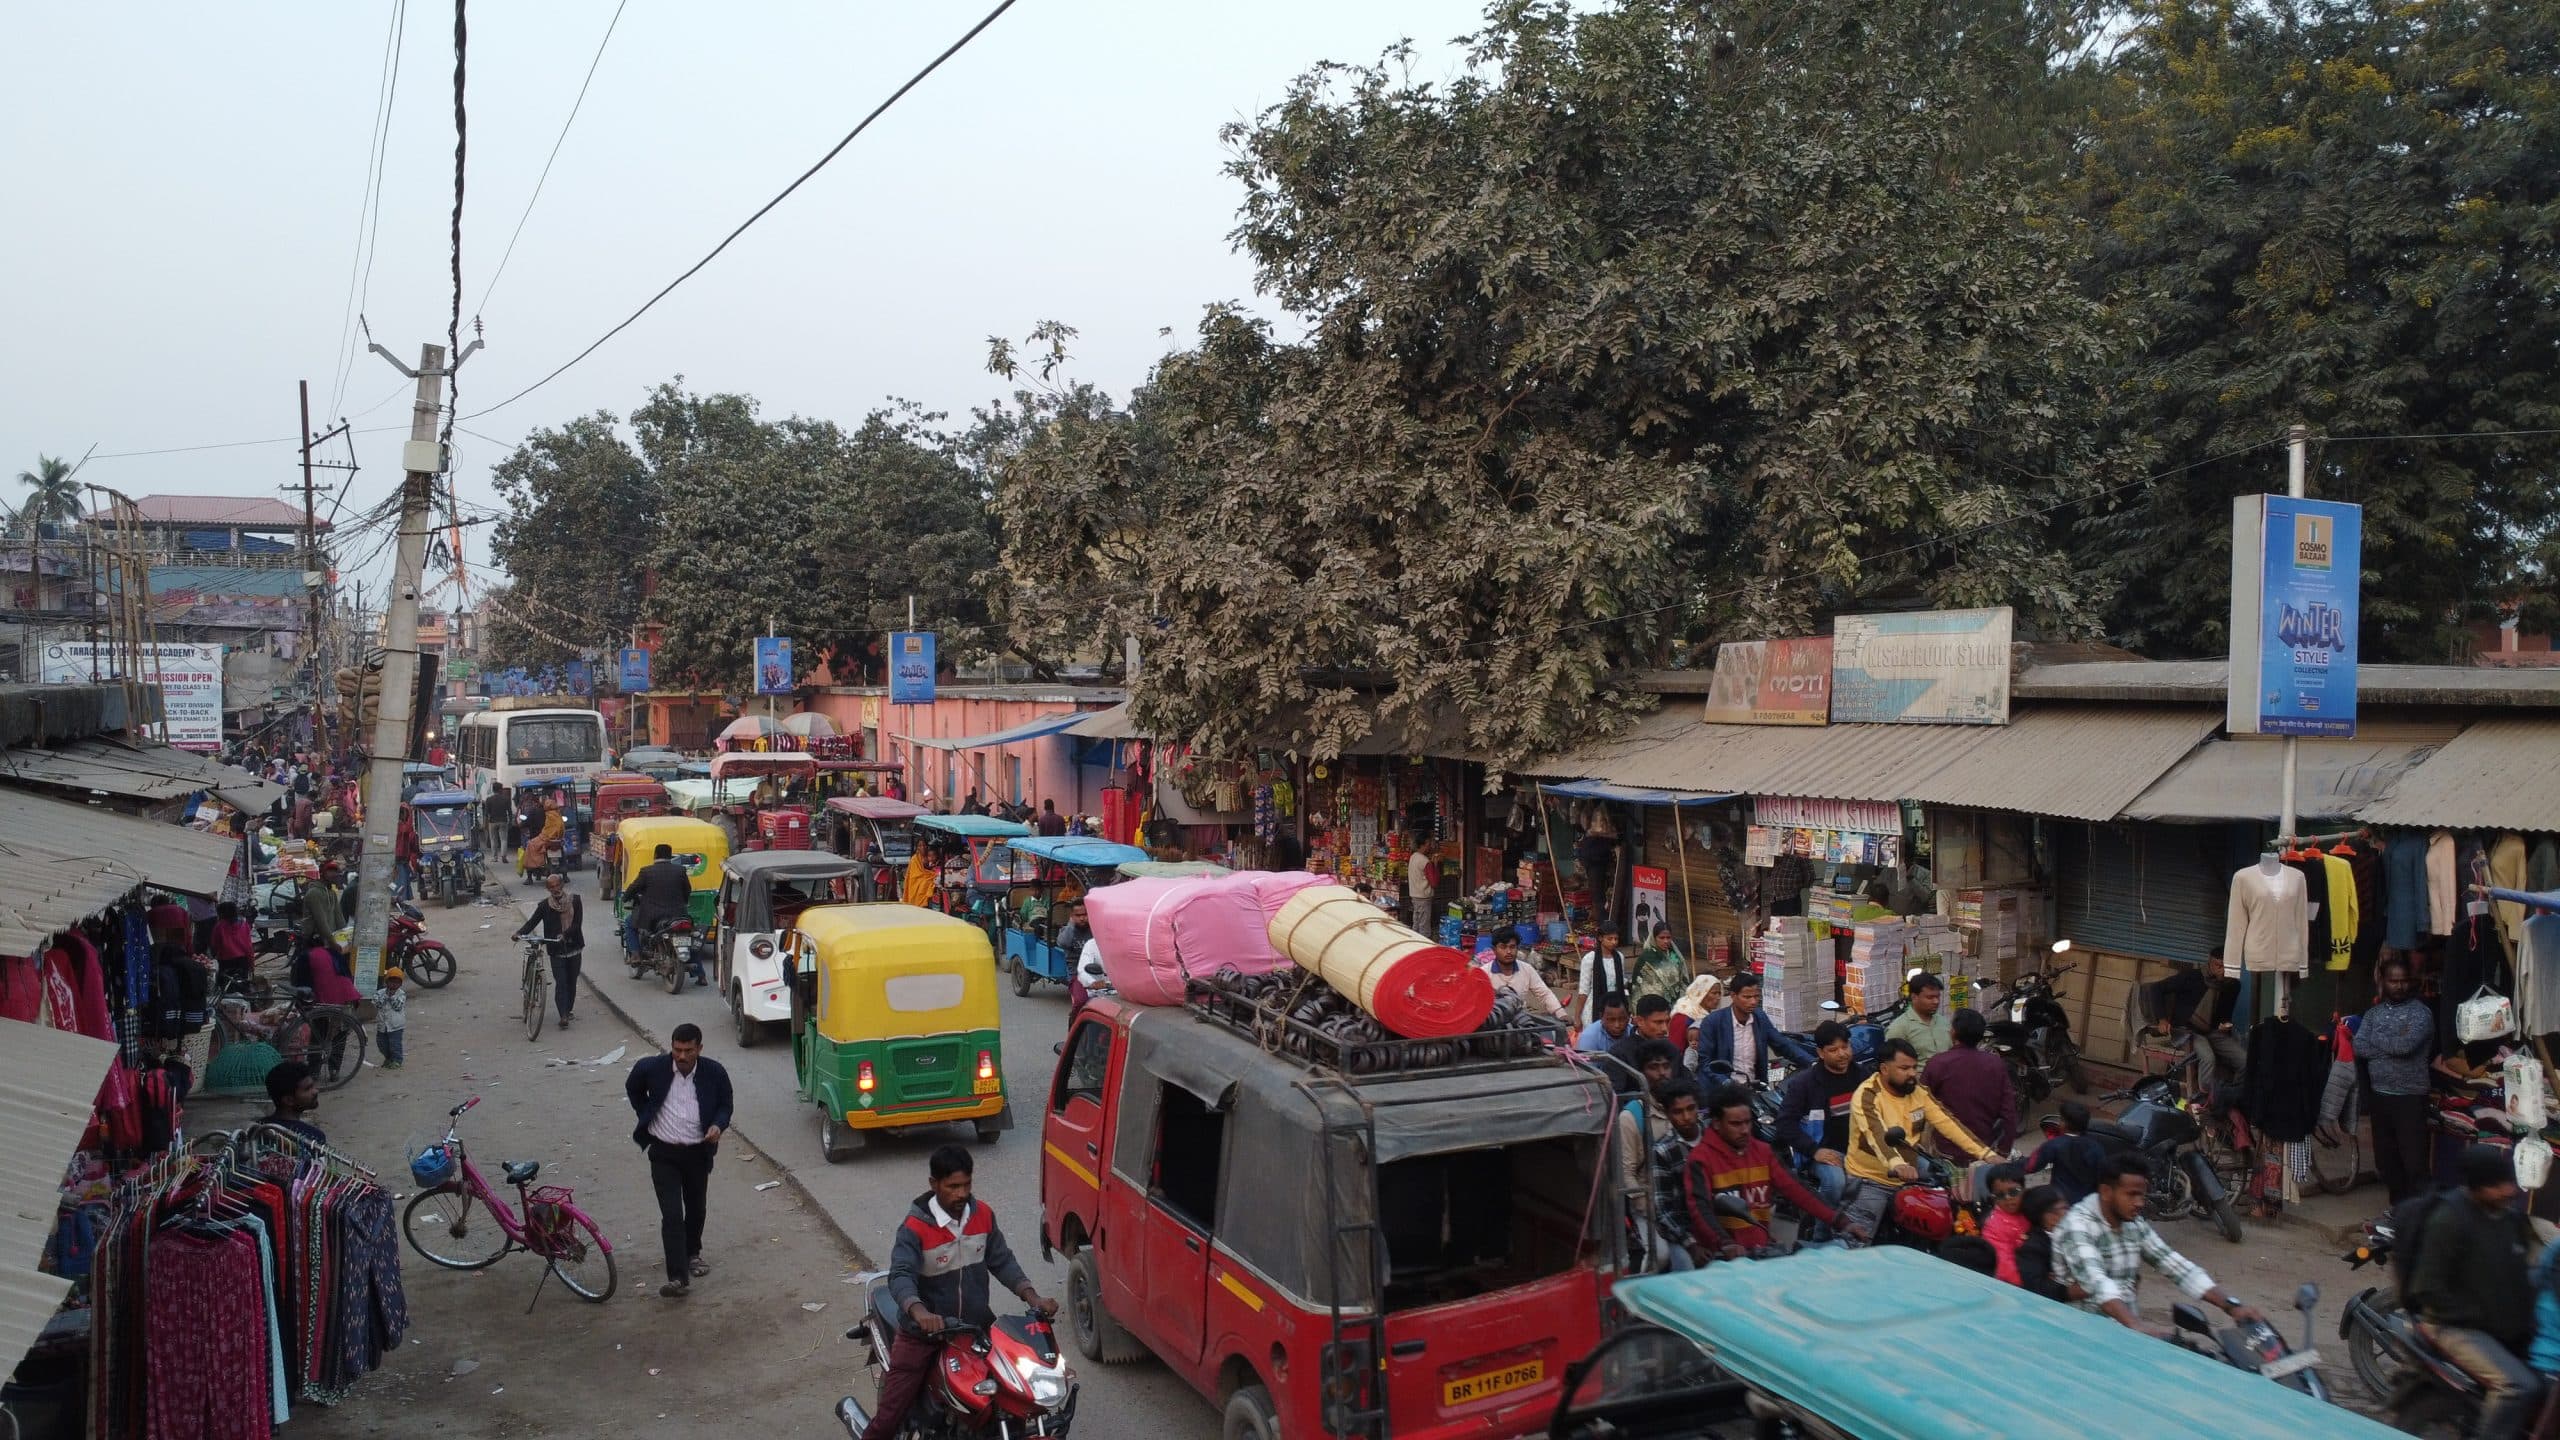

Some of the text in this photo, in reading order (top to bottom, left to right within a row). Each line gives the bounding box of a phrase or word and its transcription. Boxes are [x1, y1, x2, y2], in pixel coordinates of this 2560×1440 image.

[2299, 541, 2327, 553] COSMO
[2299, 551, 2327, 562] BAZAAR
[2279, 601, 2346, 652] WINTER
[2295, 651, 2328, 665] STYLE
[191, 672, 213, 683] OPEN
[551, 766, 585, 774] TRAVELS
[1757, 797, 1899, 833] NISHA BOOK STORE
[1452, 1365, 1537, 1400] BR 11F 0766
